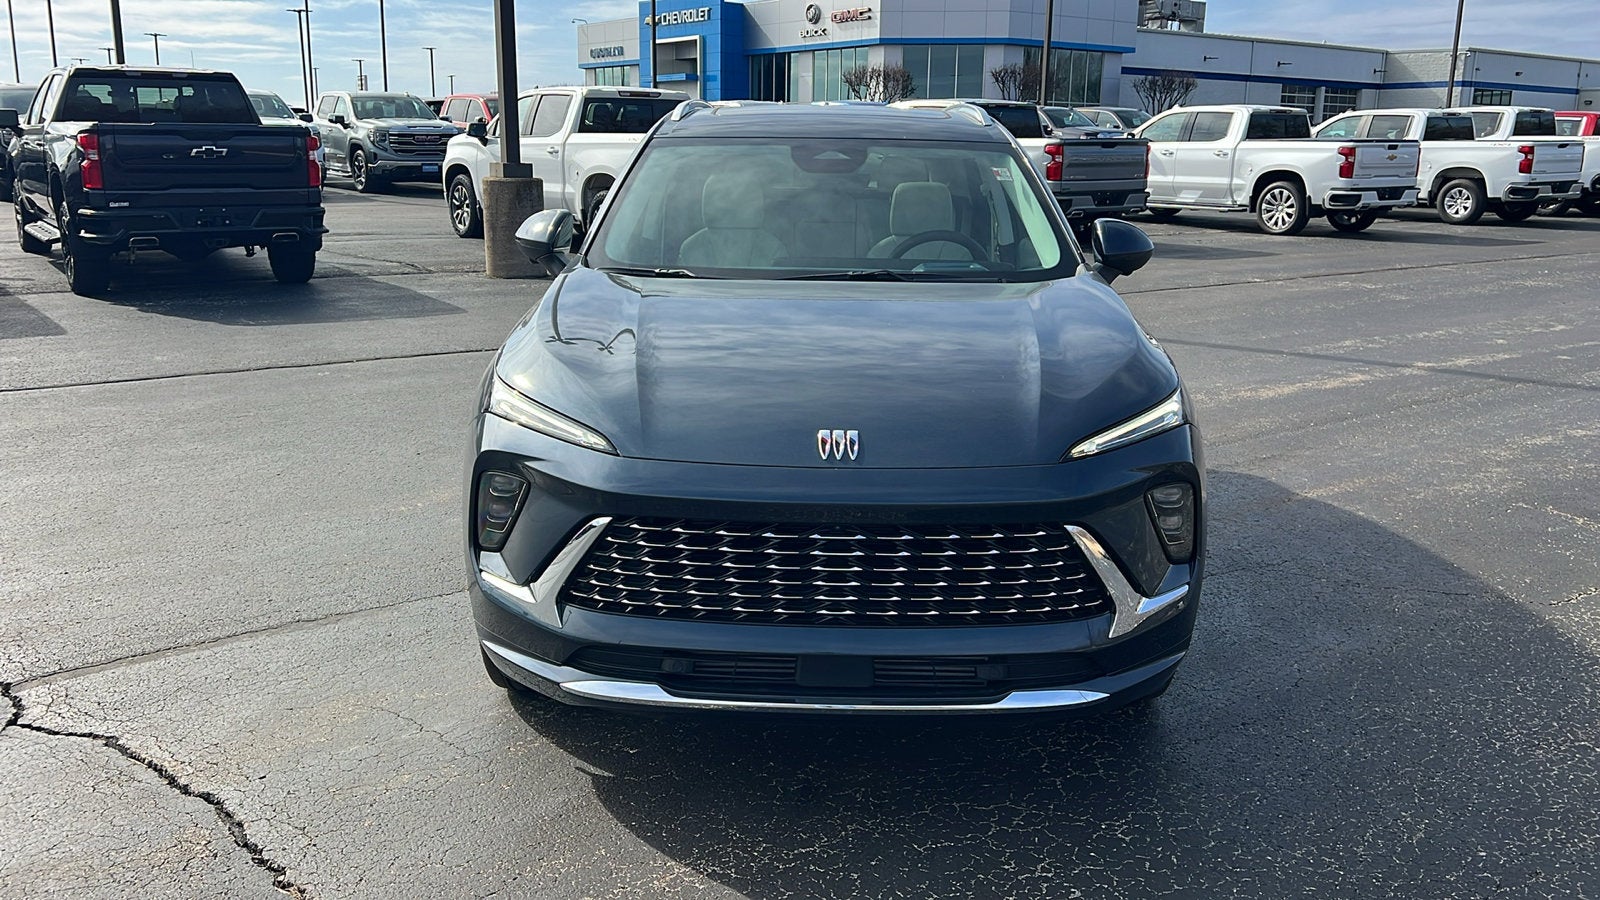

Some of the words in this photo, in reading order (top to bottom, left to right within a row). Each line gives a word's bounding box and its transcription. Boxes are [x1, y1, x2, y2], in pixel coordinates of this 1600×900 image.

[661, 7, 710, 26] CHEVROLET
[831, 7, 871, 23] GMC
[799, 27, 827, 38] BUICK
